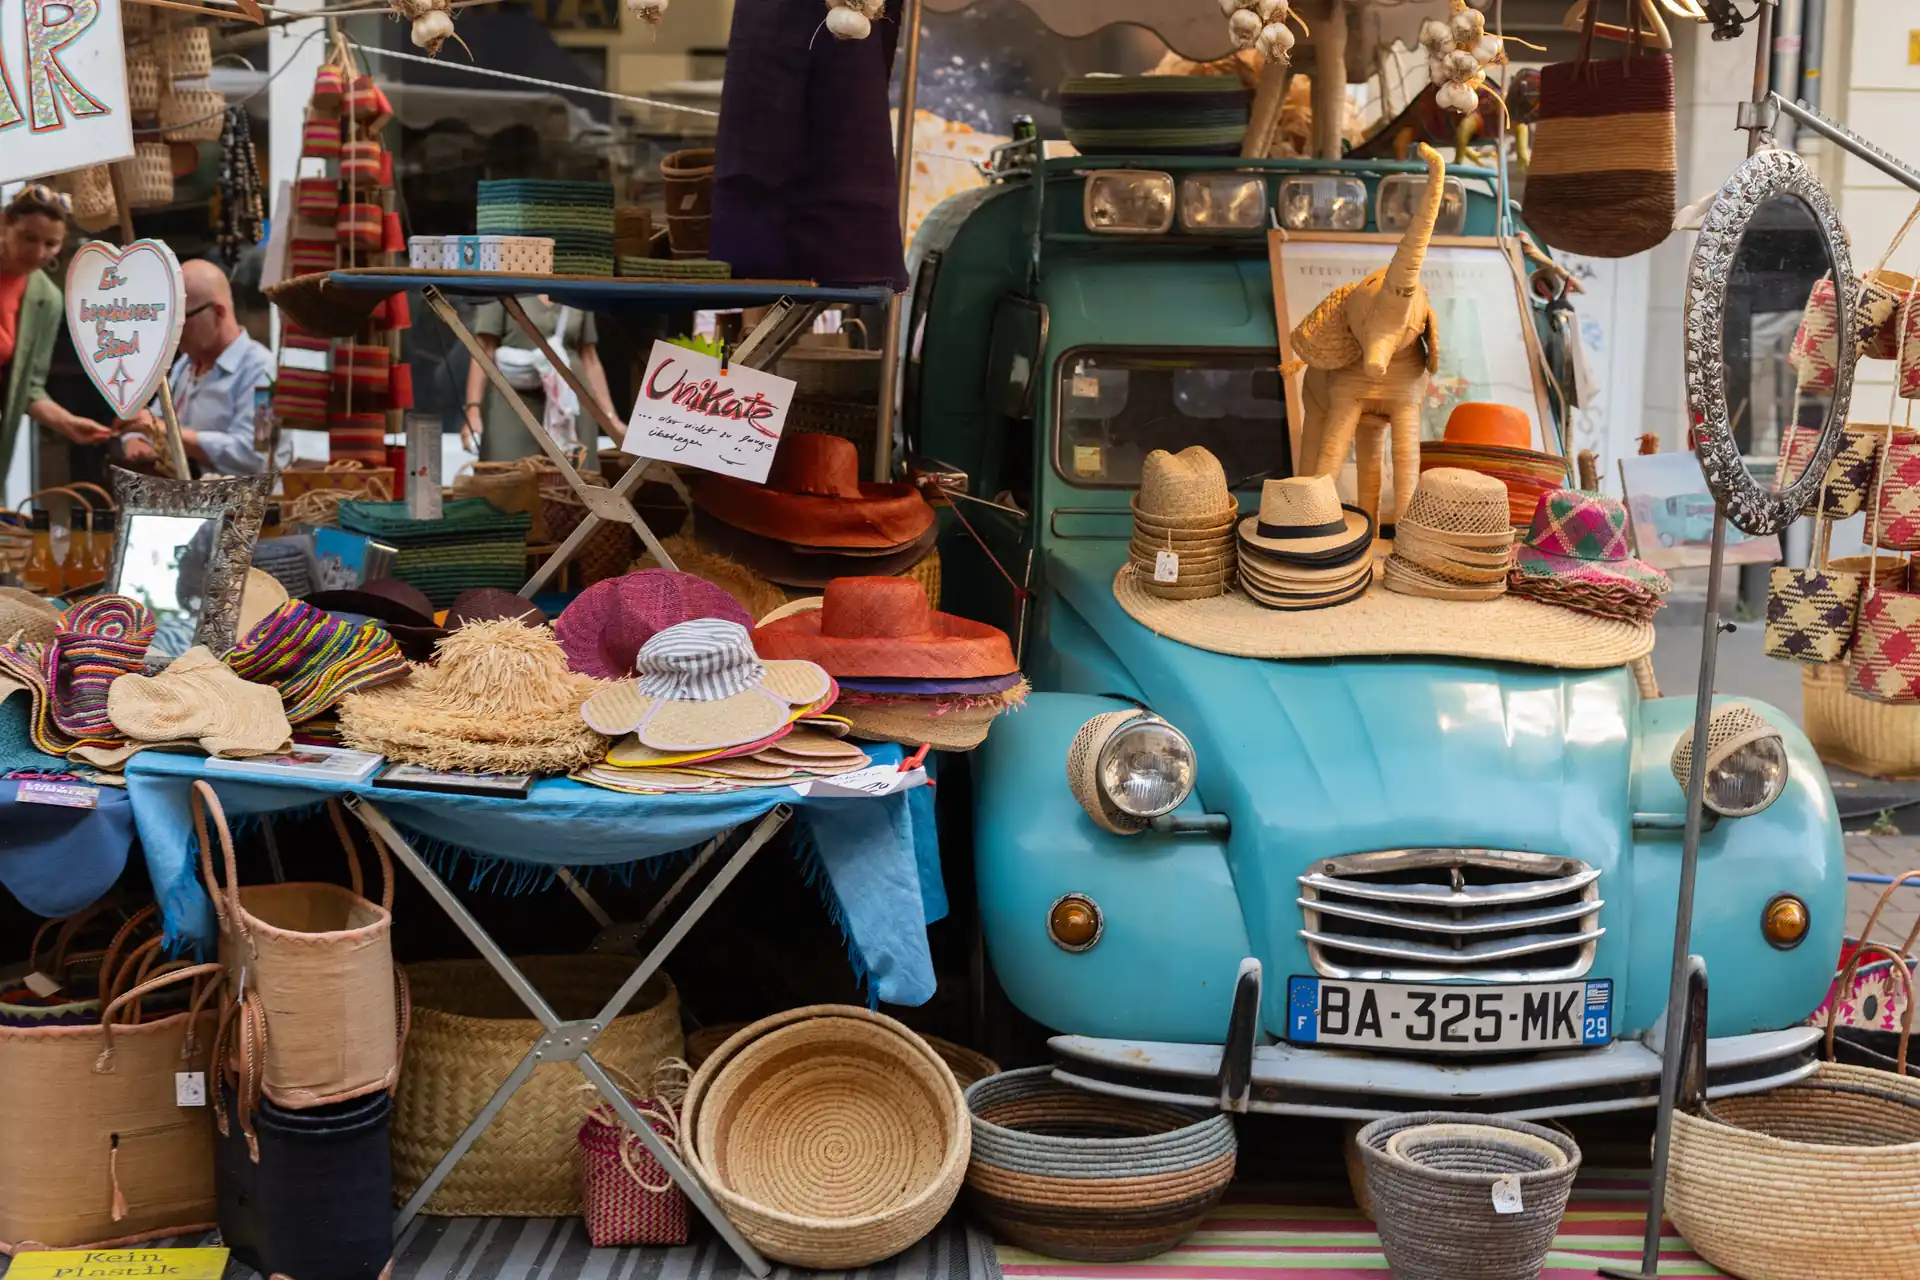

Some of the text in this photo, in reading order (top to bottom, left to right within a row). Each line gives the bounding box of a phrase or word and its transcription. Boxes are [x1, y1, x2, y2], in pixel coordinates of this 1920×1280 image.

[0, 0, 112, 135] R
[93, 330, 141, 363] Stand
[658, 415, 683, 425] also
[684, 422, 718, 434] nicht
[720, 431, 732, 439] zu
[1297, 1016, 1308, 1030] F
[1320, 985, 1580, 1043] BA-325-MK
[1585, 1017, 1608, 1039] 29
[84, 1252, 165, 1264] Kein
[52, 1264, 182, 1278] Plastik
